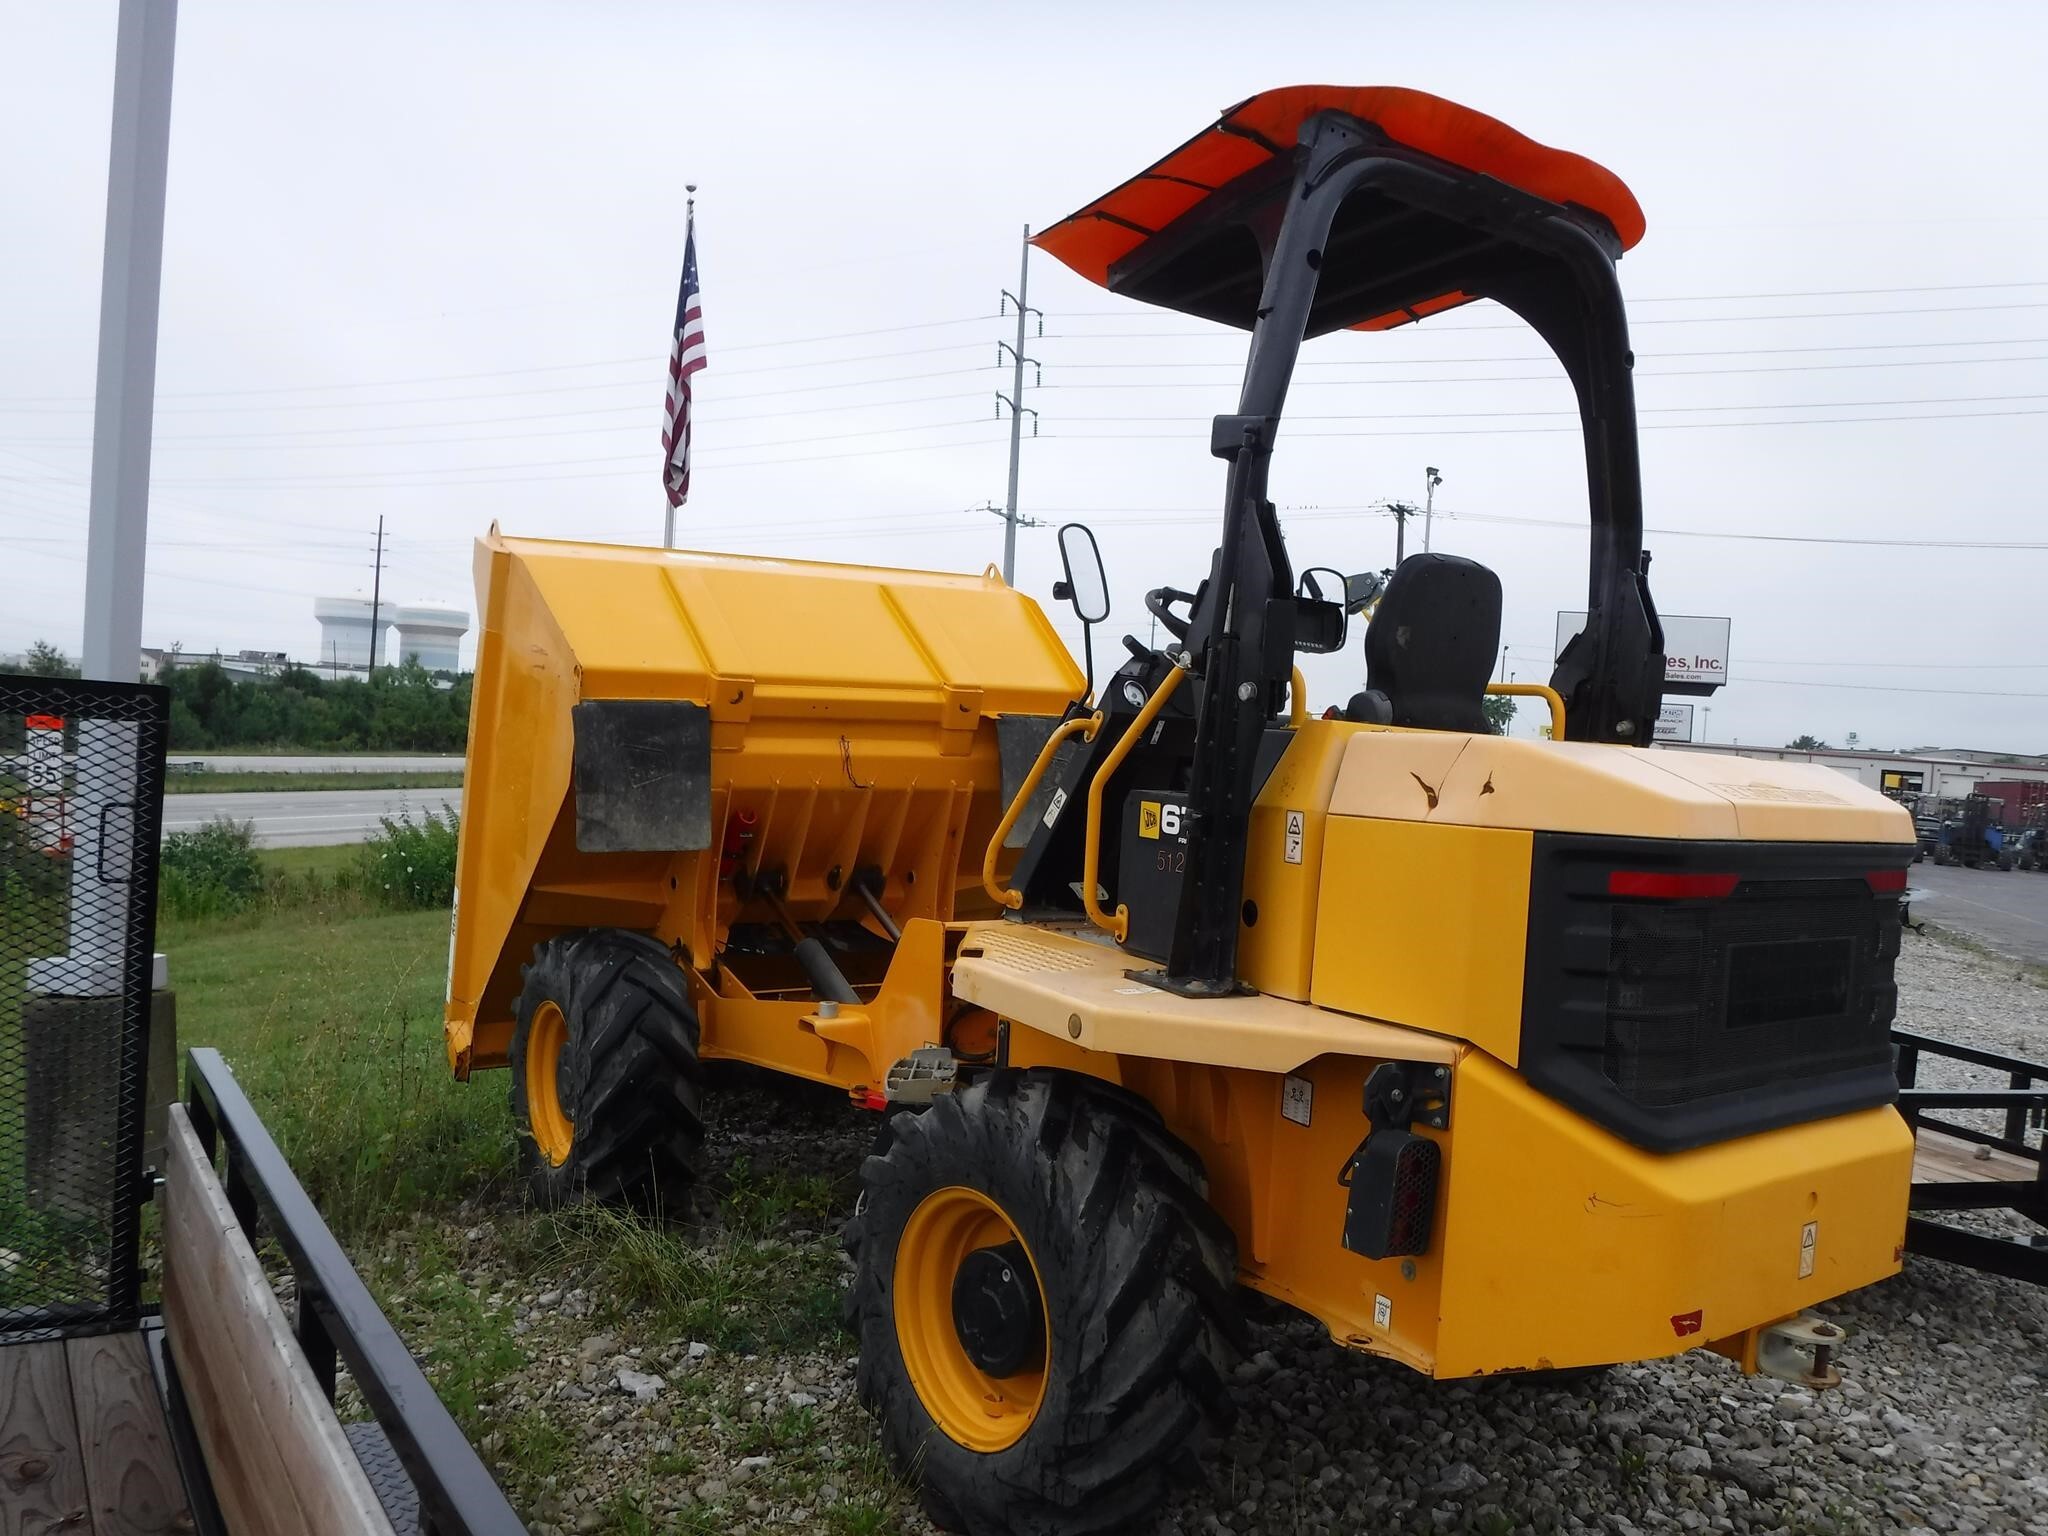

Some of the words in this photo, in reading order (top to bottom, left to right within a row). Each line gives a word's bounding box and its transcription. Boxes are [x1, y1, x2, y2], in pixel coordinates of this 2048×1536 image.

[1695, 655, 1723, 670] Inc.
[30, 735, 60, 746] SPEED
[32, 750, 57, 760] LIMIT
[32, 765, 57, 784] 55
[1157, 850, 1185, 873] 512
